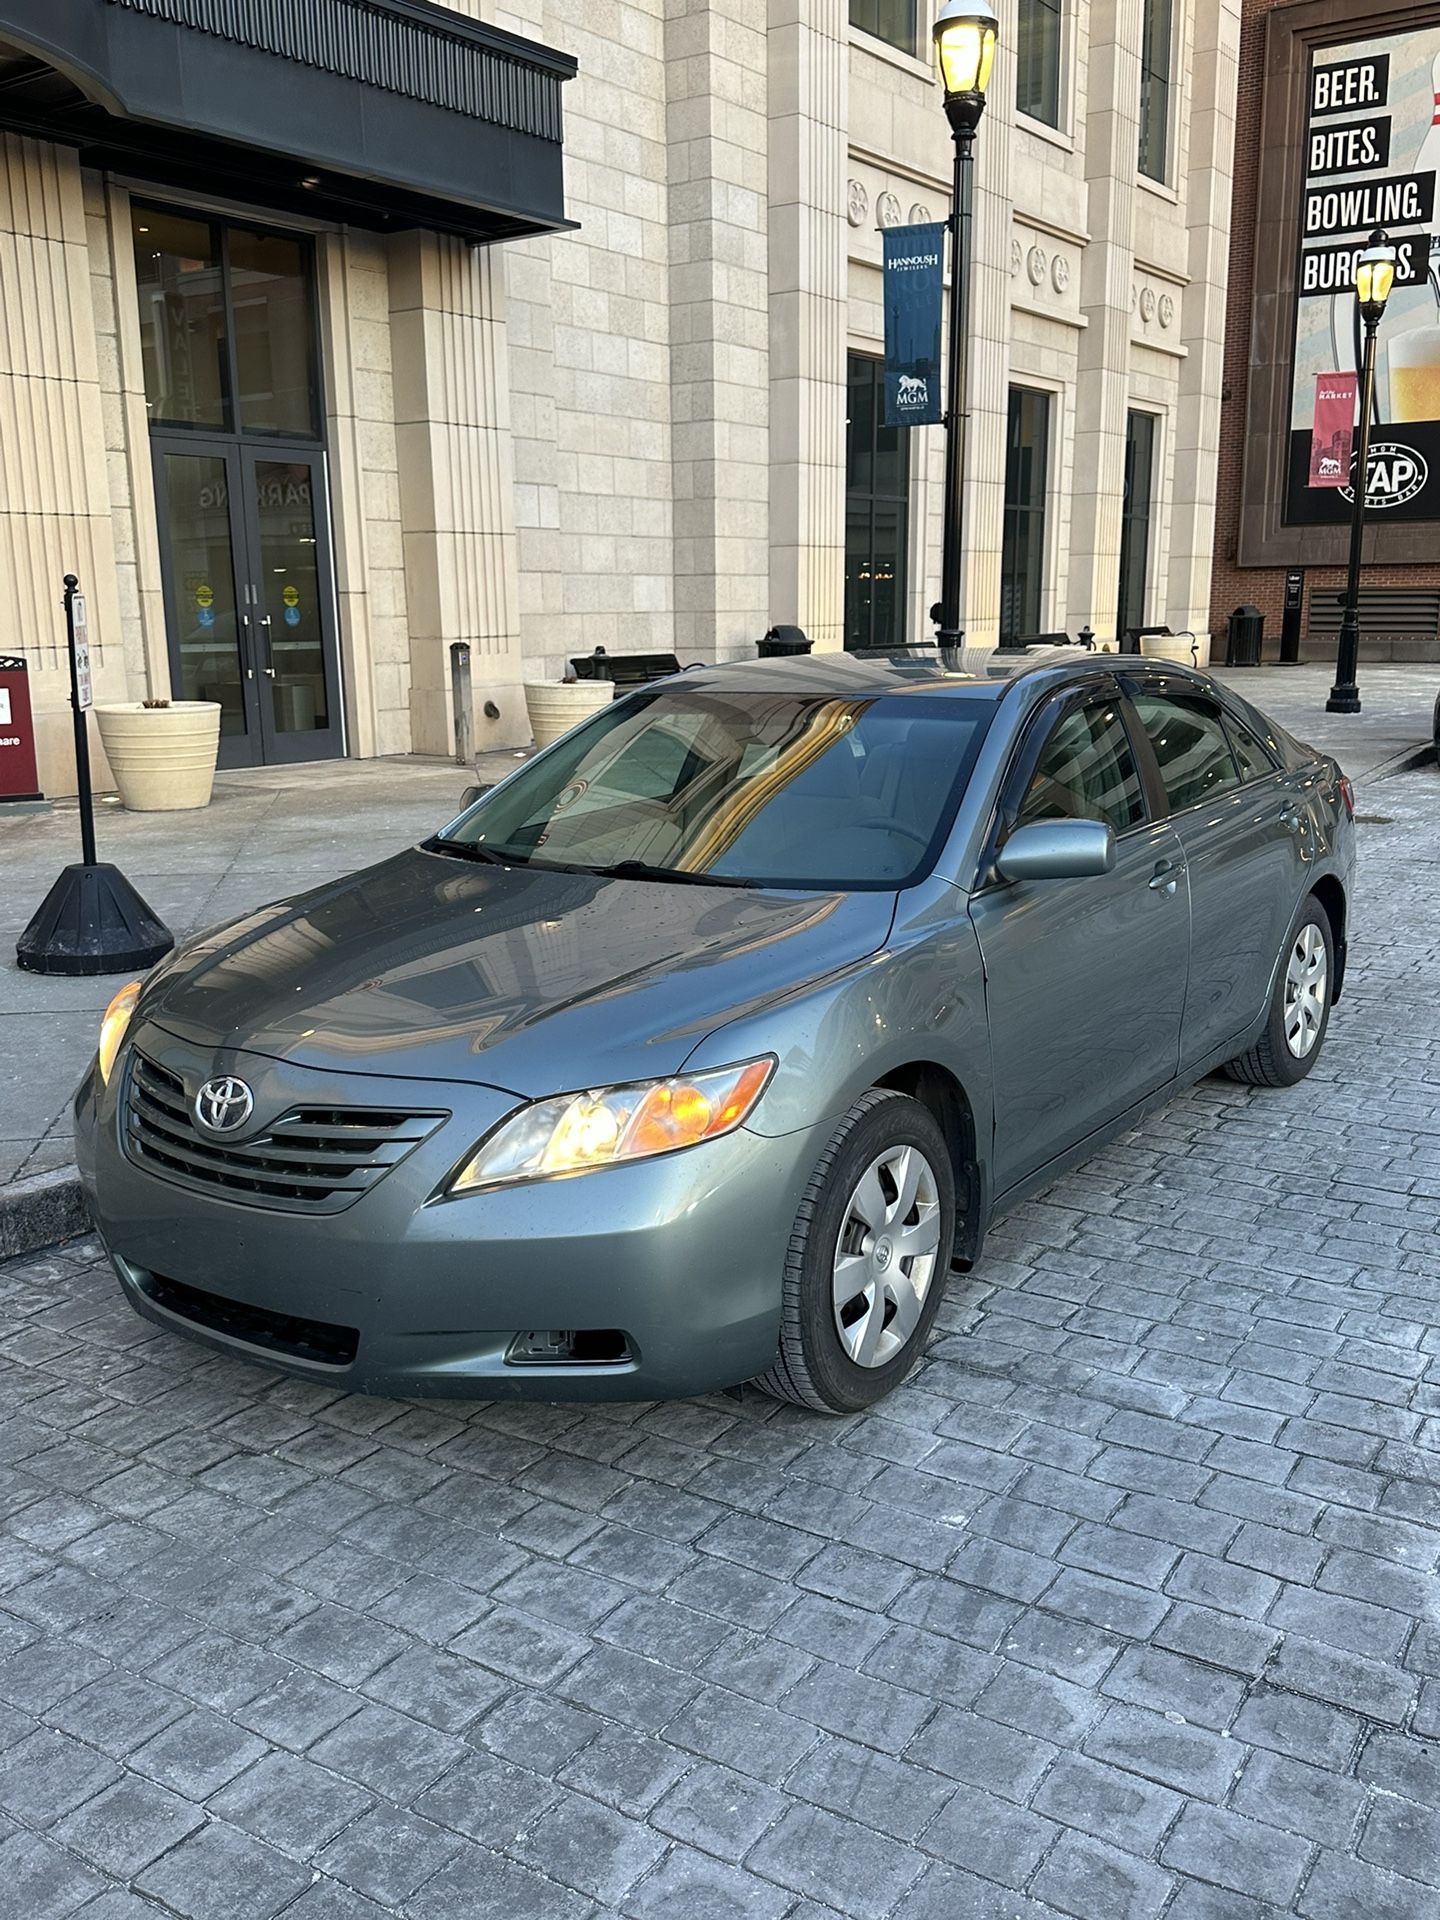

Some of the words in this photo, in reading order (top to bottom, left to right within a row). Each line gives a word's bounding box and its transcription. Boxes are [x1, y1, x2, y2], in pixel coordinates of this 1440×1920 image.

[1314, 65, 1379, 110] BEER.
[1310, 126, 1380, 171] BITES.
[1306, 182, 1422, 231] BOWLING.
[888, 254, 938, 270] HANNOUSH
[1303, 243, 1416, 291] BURGS.
[896, 391, 928, 404] MGM
[1319, 392, 1352, 400] MARKET
[1370, 445, 1397, 454] MGM
[1343, 486, 1387, 505] SRTS
